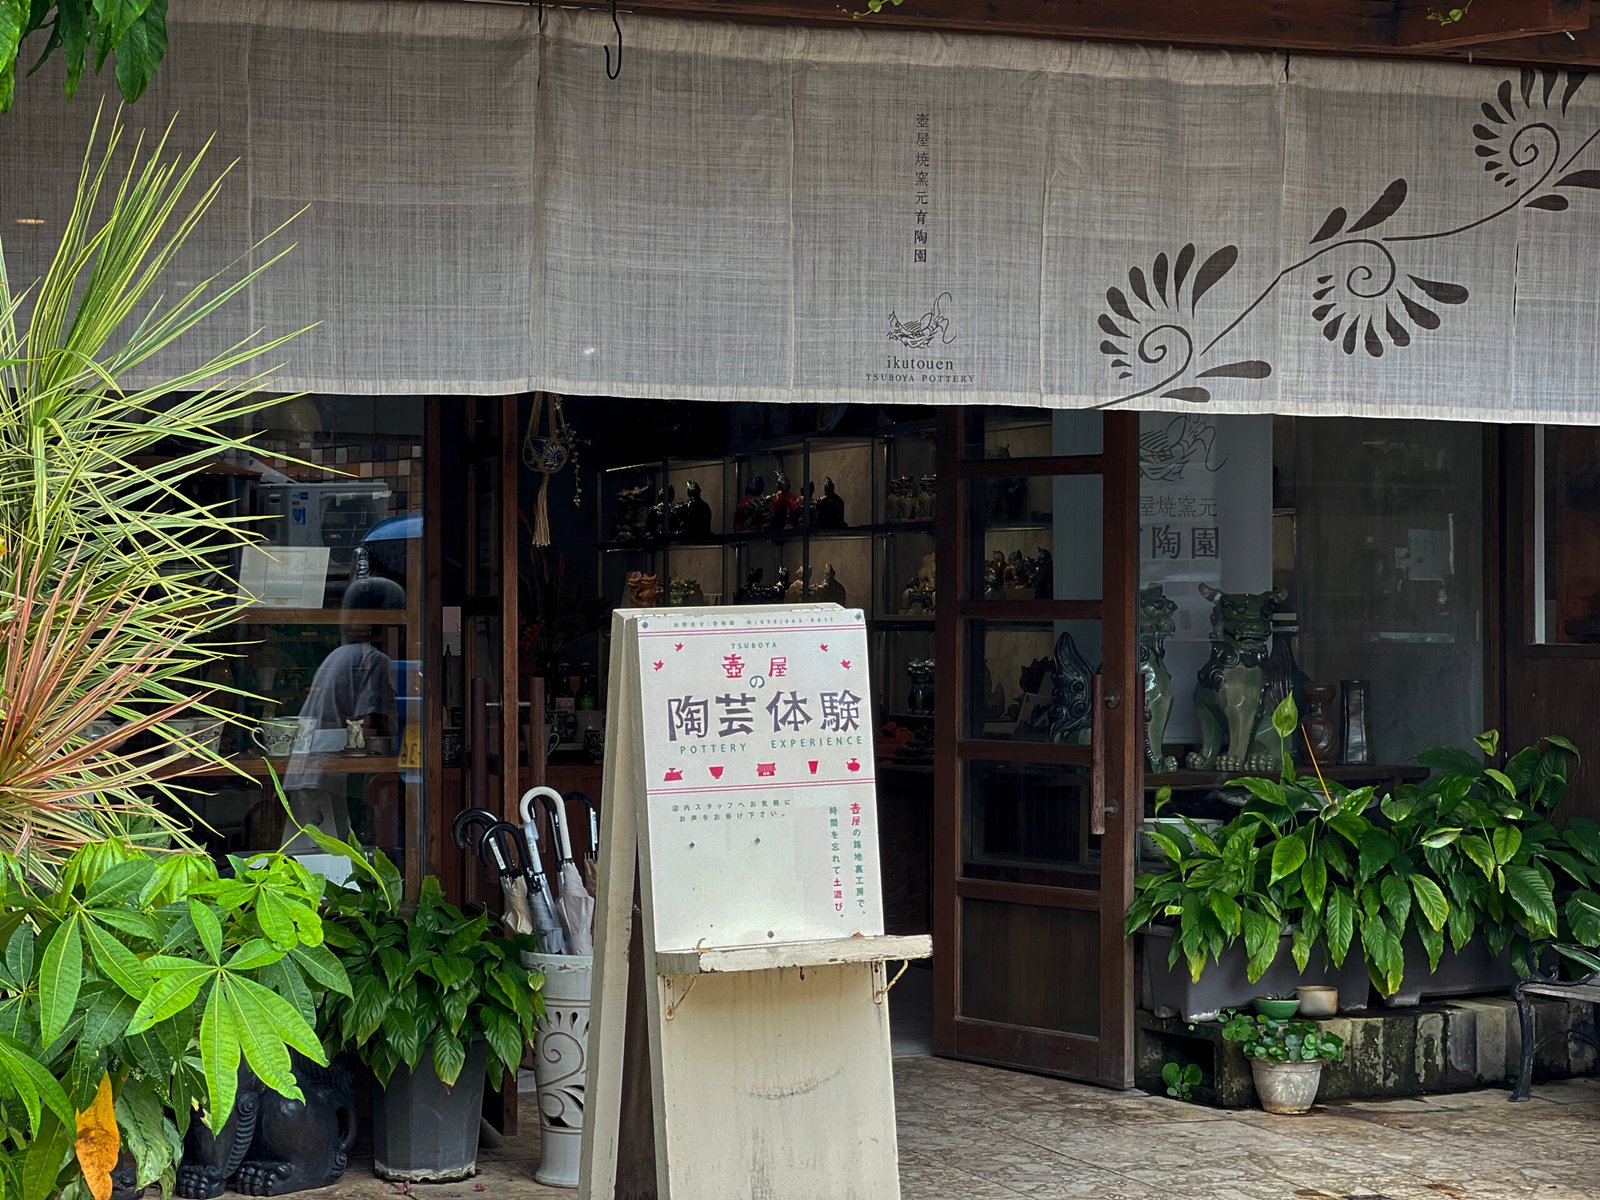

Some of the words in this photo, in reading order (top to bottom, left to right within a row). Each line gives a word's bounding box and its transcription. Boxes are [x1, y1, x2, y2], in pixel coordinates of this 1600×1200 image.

[887, 355, 953, 370] ikutouen
[866, 373, 915, 382] TSUBOYA
[922, 374, 975, 383] POTTERY
[1140, 524, 1219, 559] 陶園
[731, 641, 778, 650] TSUBOYA
[667, 689, 863, 742] 陶芸体験
[680, 742, 747, 755] POTTERY
[771, 735, 863, 749] EXPERIENCE
